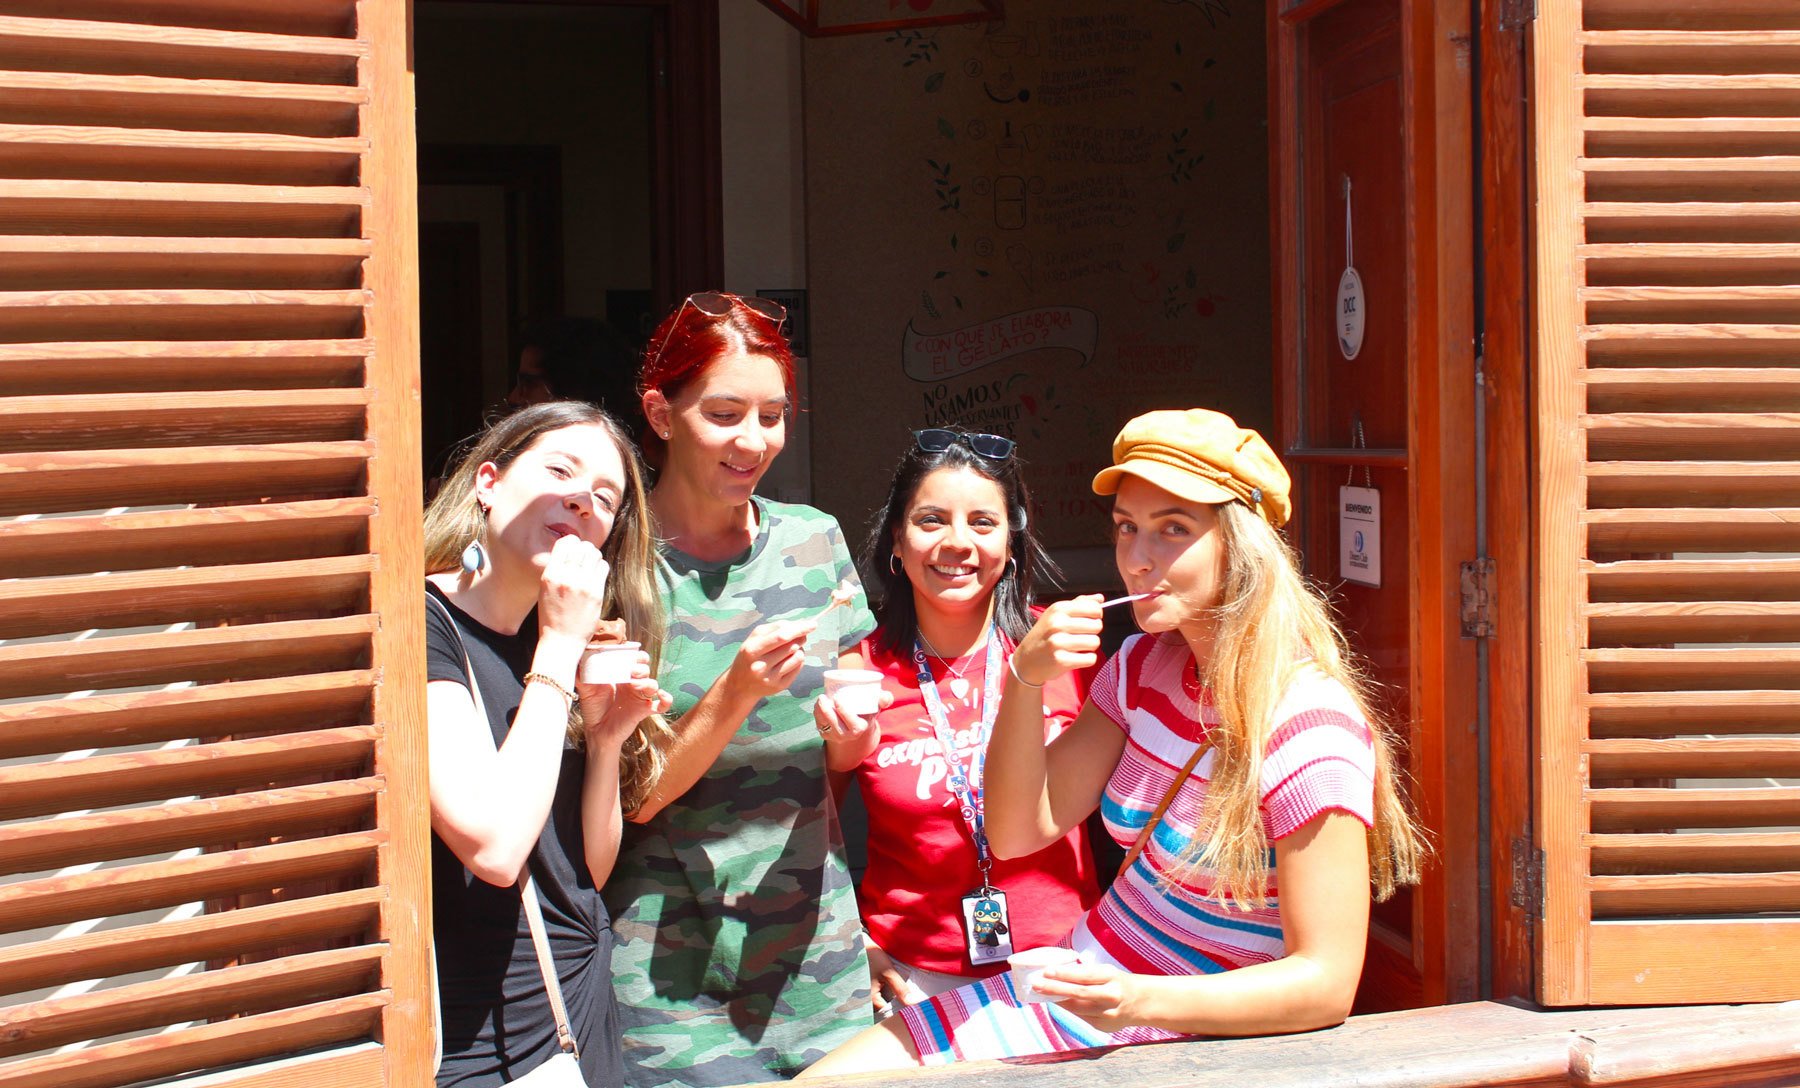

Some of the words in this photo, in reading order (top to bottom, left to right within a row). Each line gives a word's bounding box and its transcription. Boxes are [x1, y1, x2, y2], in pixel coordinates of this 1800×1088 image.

[1344, 296, 1356, 314] DCC
[990, 323, 1003, 342] SE
[1011, 311, 1073, 331] ELABORA
[932, 355, 953, 375] EL
[923, 384, 948, 411] NO
[925, 380, 1002, 427] USAMOS
[1345, 503, 1373, 515] BIENVENIDO
